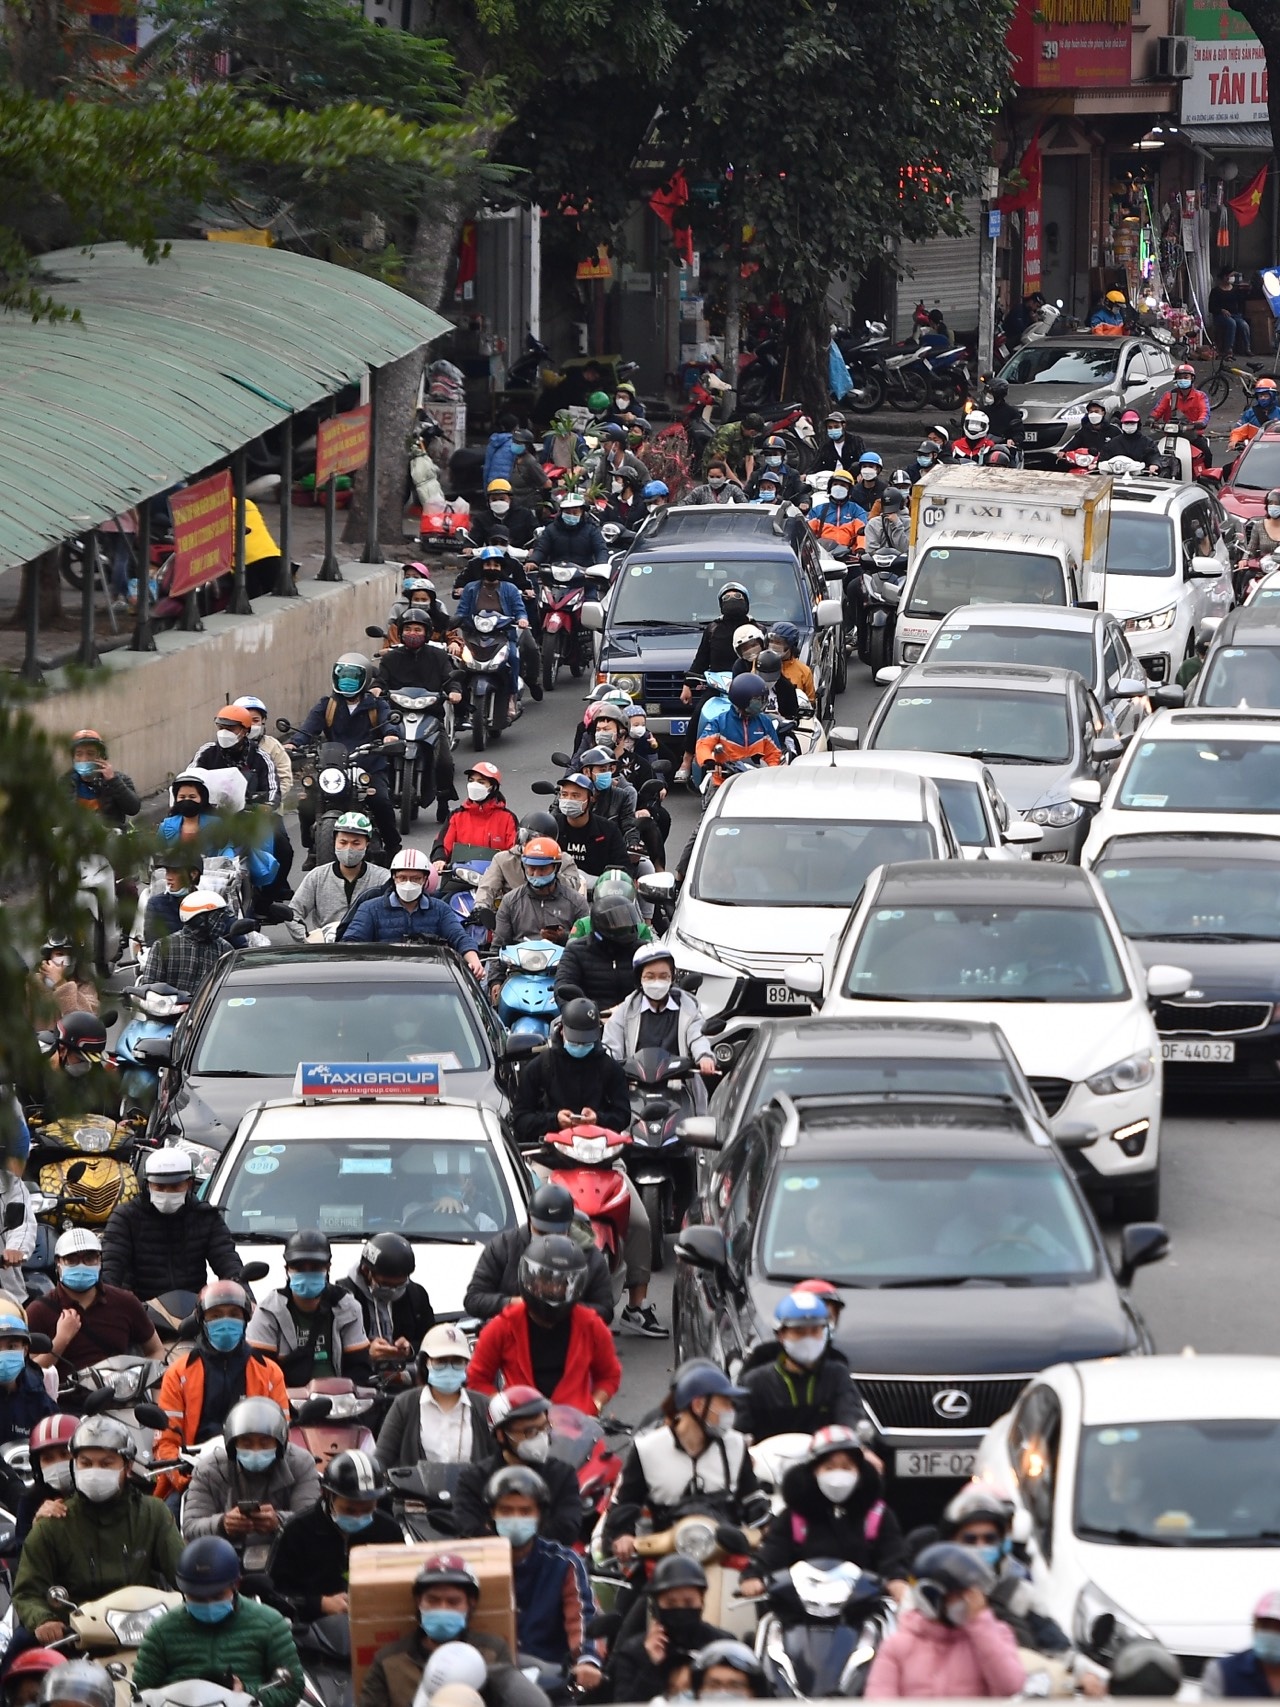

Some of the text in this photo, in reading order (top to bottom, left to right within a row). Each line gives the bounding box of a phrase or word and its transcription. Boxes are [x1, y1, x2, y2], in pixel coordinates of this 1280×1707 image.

[1208, 66, 1246, 105] TÂN
[321, 1072, 435, 1084] TAXIGROUP
[331, 1086, 411, 1095] www.taxigroup.com.vn
